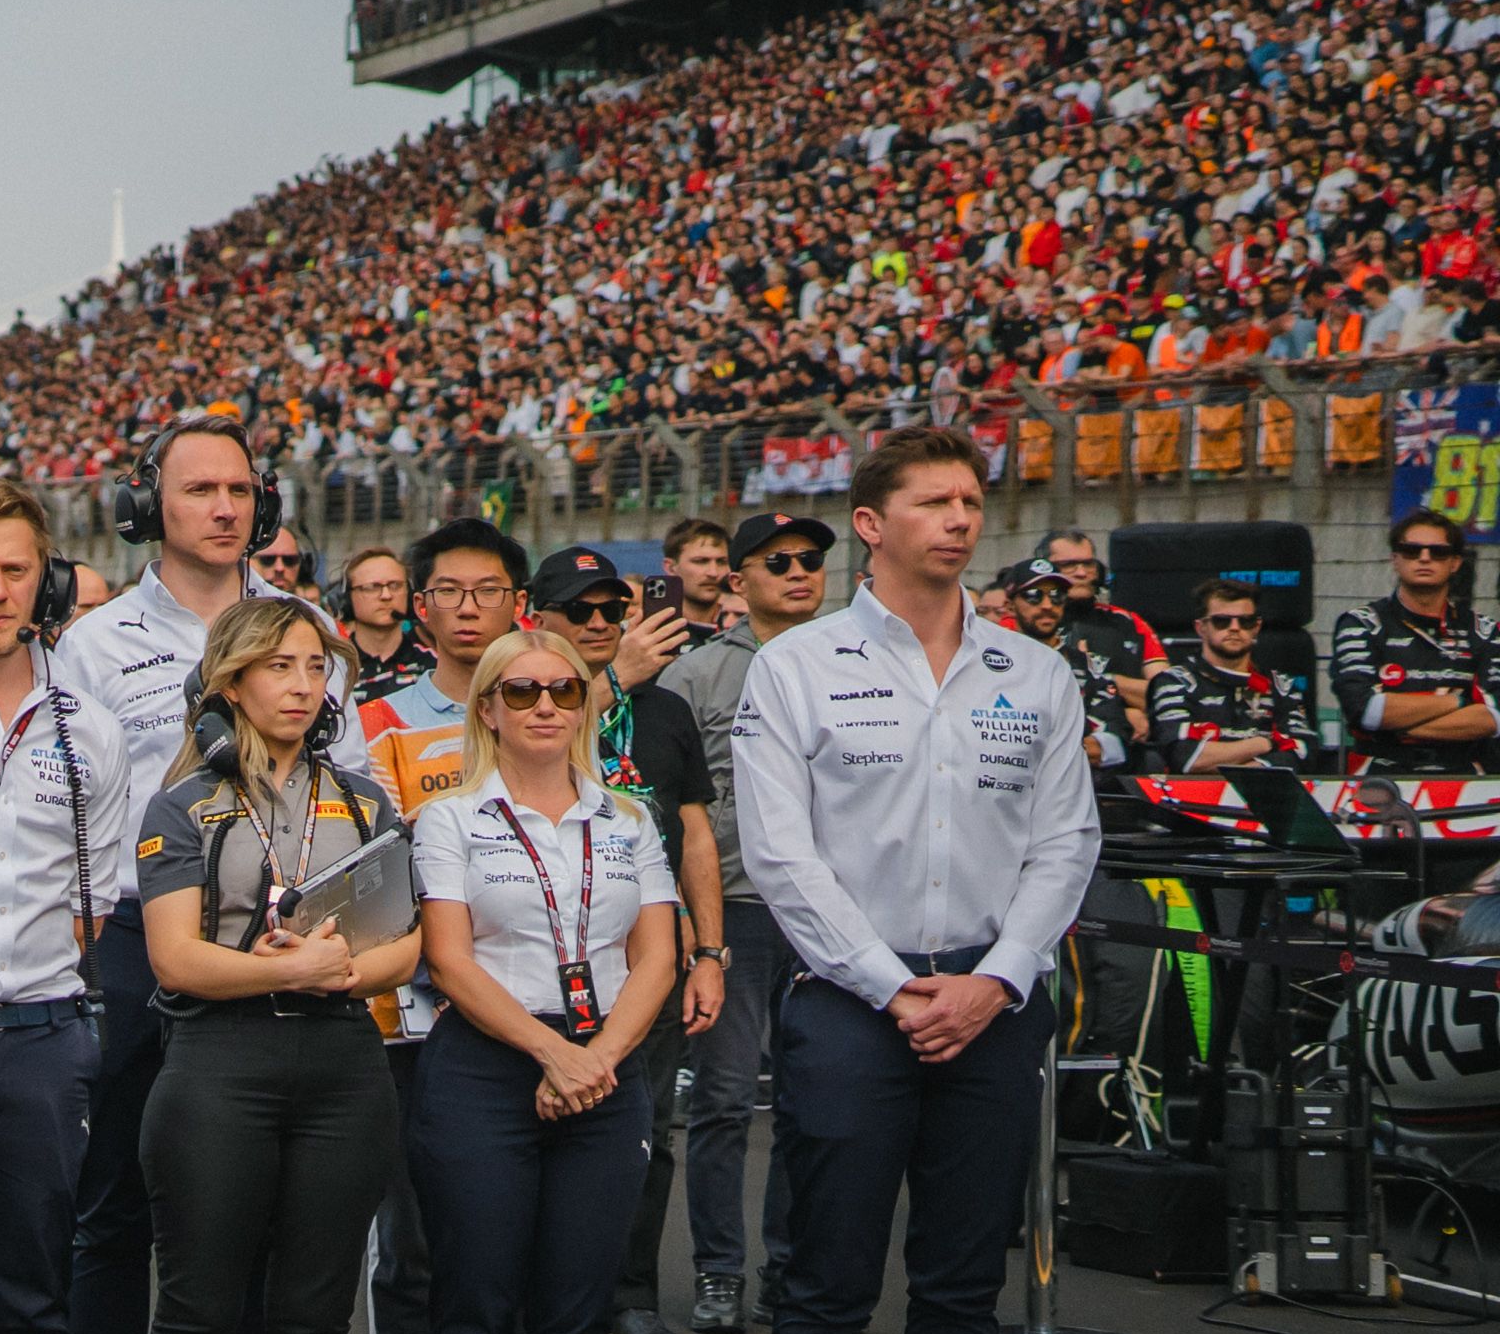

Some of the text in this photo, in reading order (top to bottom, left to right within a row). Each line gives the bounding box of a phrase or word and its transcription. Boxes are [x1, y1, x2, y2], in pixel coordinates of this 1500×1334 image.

[121, 653, 175, 676] KOMATSU
[135, 682, 182, 700] MYPROTEIN
[830, 688, 893, 701] KOMATSU
[133, 711, 184, 732] Stephens
[971, 709, 1038, 721] ATLASSIAN
[972, 720, 1038, 734] WILLIAMS
[981, 731, 1032, 745] RACING
[842, 751, 903, 767] Stephens
[980, 753, 1028, 768] DURACELL
[484, 873, 535, 884] Stephens
